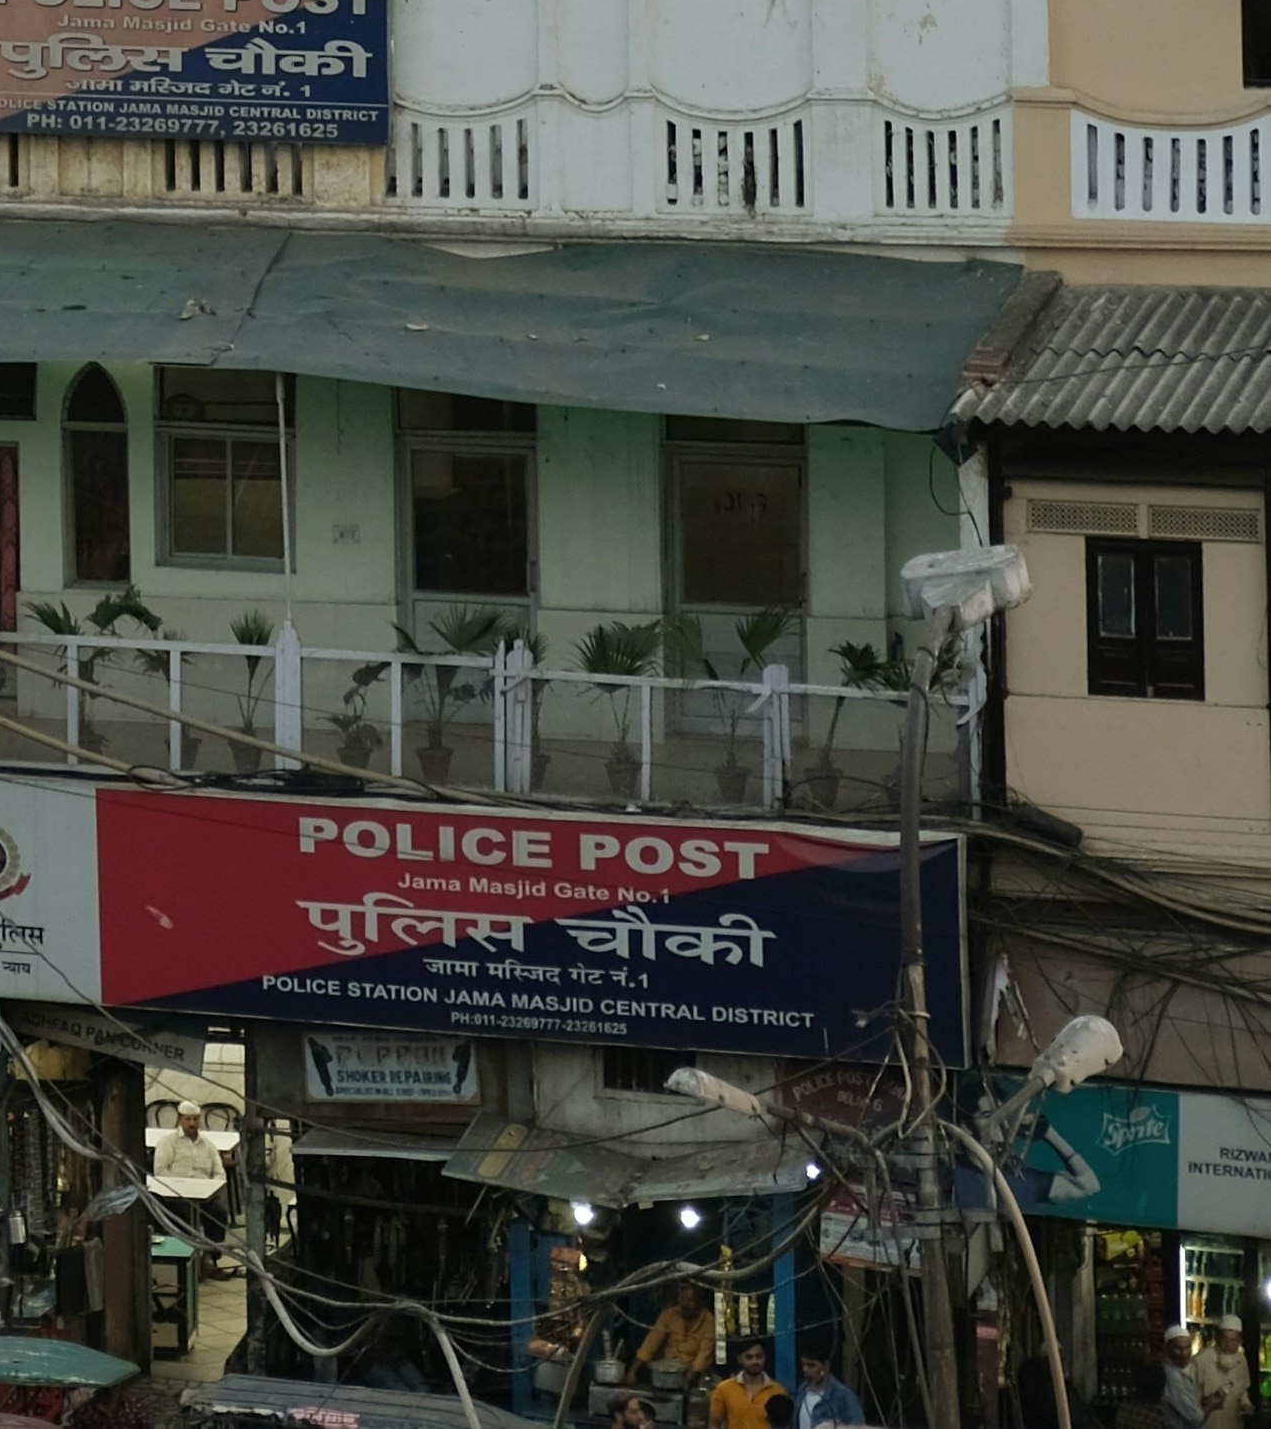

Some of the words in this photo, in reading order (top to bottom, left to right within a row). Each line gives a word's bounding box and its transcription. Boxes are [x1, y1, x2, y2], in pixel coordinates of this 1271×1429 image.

[57, 14, 115, 29] Jama
[123, 16, 193, 33] Masjid
[200, 19, 251, 33] Gate
[259, 20, 306, 34] No.1
[204, 37, 373, 78] चौकी
[66, 79, 126, 92] जामा
[129, 76, 212, 95] मस्जिद
[218, 79, 257, 97] गेट
[26, 113, 62, 128] PH:
[233, 121, 338, 138] 23261625
[47, 100, 114, 112] STATION
[119, 102, 161, 114] JAMA
[166, 104, 225, 116] MASJID
[229, 106, 301, 119] CENTRAL
[306, 108, 379, 121] DISTRICT
[298, 817, 553, 868] POLICE
[579, 833, 769, 880] POST
[398, 873, 461, 891] Jama
[469, 877, 546, 899] Masjid
[554, 881, 609, 901] Gate
[617, 885, 670, 903] No.1
[295, 891, 534, 956] पुलिस
[555, 905, 777, 967] चौकी
[423, 958, 479, 978] जामा
[485, 959, 562, 985] मस्जिद
[567, 962, 605, 984] गेट
[262, 975, 341, 996] POLICE
[347, 983, 438, 1002] STATION
[444, 989, 506, 1008] JAMA
[512, 993, 593, 1013] MASJID
[600, 999, 706, 1020] CENTRAL
[712, 1006, 815, 1028] DISTRICT
[336, 1069, 386, 1083] SHOKER
[389, 1070, 452, 1084] REPAIRING
[792, 1072, 835, 1102] POLICE
[1104, 1118, 1164, 1149] Sprite
